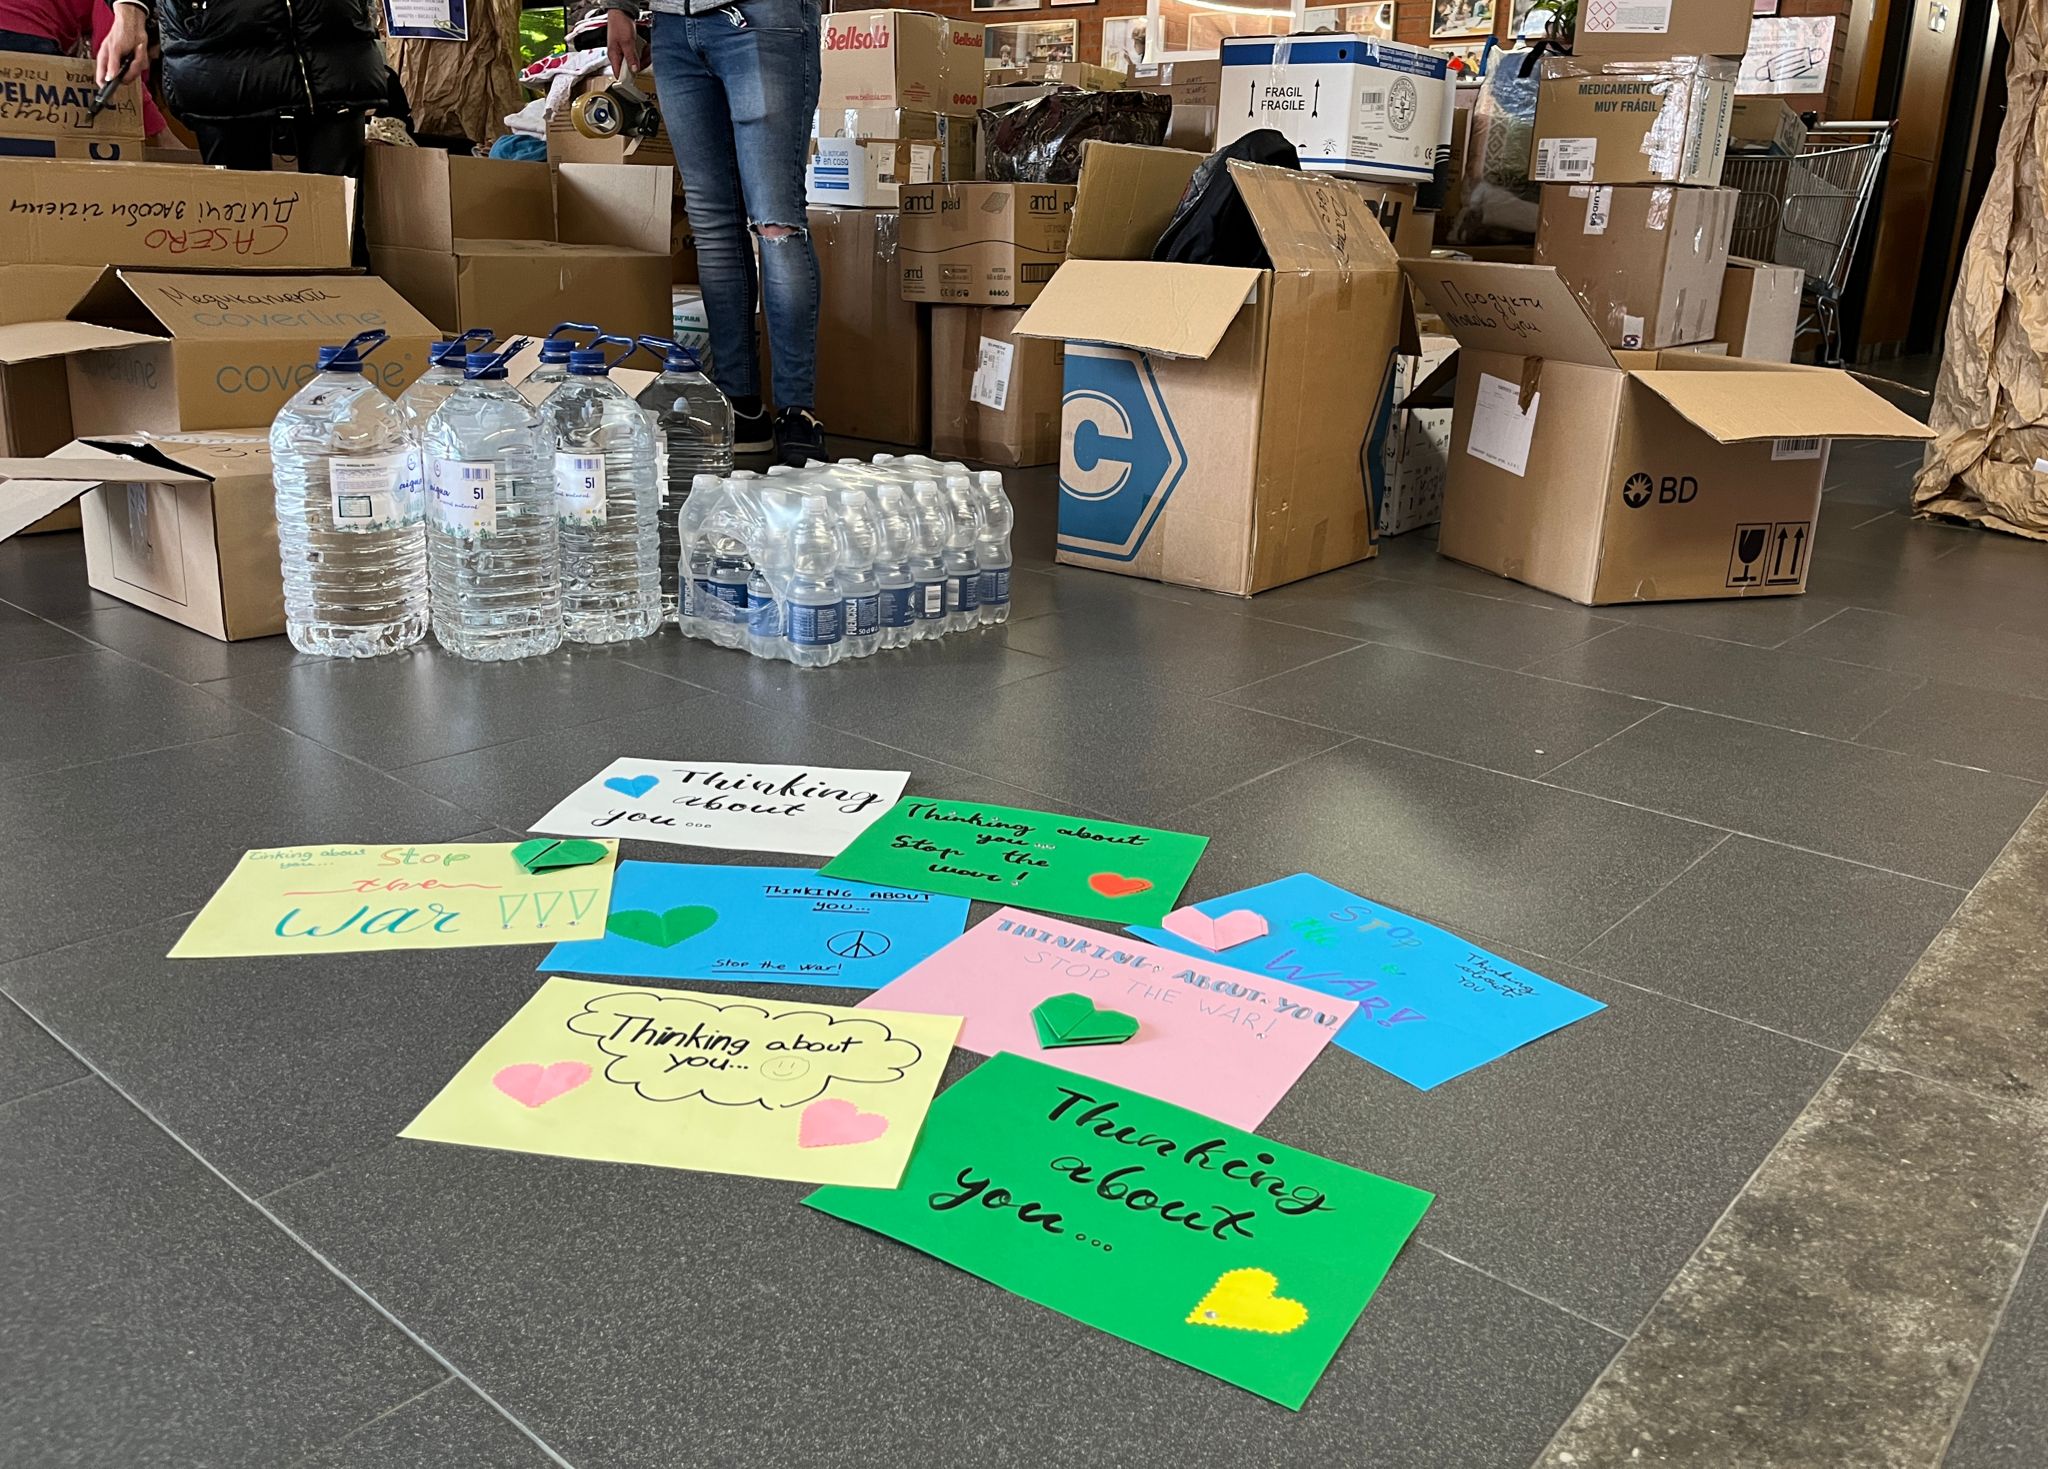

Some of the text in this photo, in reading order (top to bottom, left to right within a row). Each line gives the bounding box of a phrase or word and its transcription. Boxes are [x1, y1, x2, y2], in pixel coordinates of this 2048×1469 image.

[827, 25, 889, 50] Bellsolà
[953, 31, 982, 48] Bellsolà
[1265, 87, 1302, 98] FRAGIL
[1579, 83, 1655, 96] MEDICAMENTO
[1261, 100, 1305, 111] FRAGILE
[1594, 98, 1657, 112] MUY FRÁGIL
[823, 158, 848, 166] en casa
[941, 197, 960, 213] pad
[1063, 202, 1073, 213] pa
[145, 225, 289, 255] CASERO
[194, 309, 386, 328] coverline
[216, 362, 405, 393] covene
[1060, 389, 1133, 501] C
[1659, 476, 1698, 503] BD
[672, 769, 884, 813] Thinking
[673, 795, 805, 816] about
[907, 802, 1151, 846] Thinking about
[320, 848, 366, 857] about
[377, 847, 470, 866] Stop
[891, 834, 1051, 868] Stop the
[870, 892, 935, 901] ABOUT
[760, 960, 786, 970] the
[997, 917, 1153, 971] THINKING
[1172, 969, 1264, 1002] ABOUT
[1467, 952, 1540, 996] Thinking
[1024, 950, 1278, 1040] STOP THE WAR!
[609, 1013, 863, 1055] Thinking about
[1047, 1086, 1336, 1216] Thinking
[1050, 1155, 1255, 1240] about
